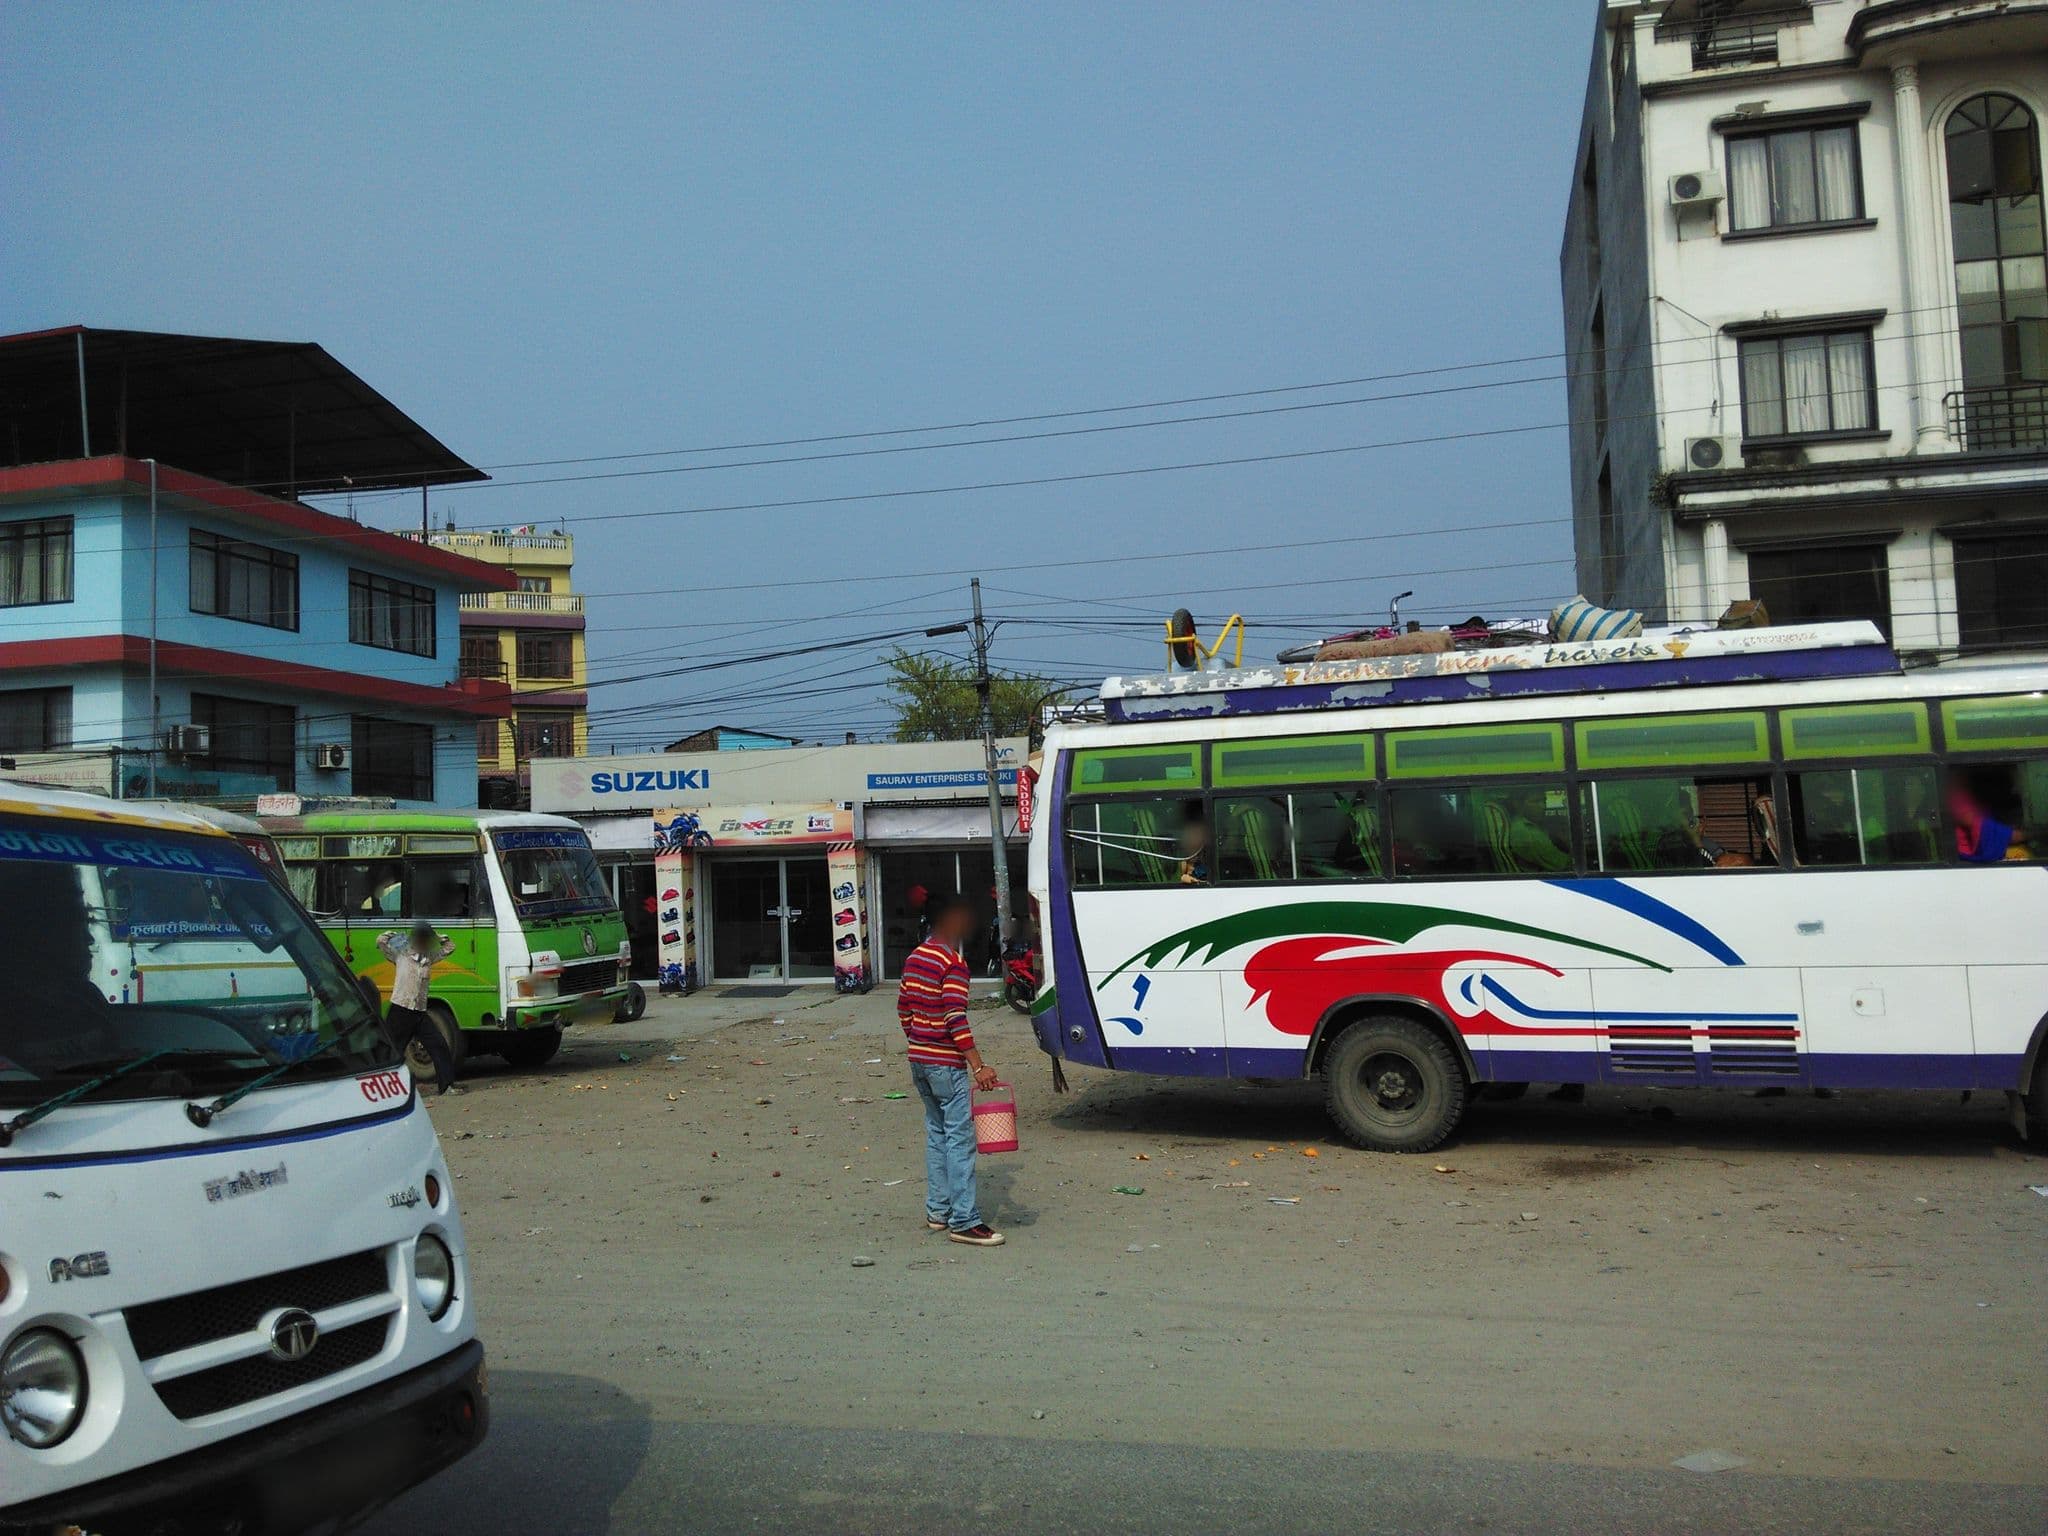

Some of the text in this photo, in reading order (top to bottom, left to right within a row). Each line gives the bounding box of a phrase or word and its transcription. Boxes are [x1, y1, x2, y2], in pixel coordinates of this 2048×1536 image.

[1543, 634, 1658, 663] travels
[591, 769, 710, 793] SUZUKI
[875, 771, 1012, 785] SAURAV ENTERPRISES SUUKI
[1018, 770, 1030, 829] TANDOORI
[356, 1071, 408, 1102] लाभ
[47, 1250, 111, 1283] ACE
